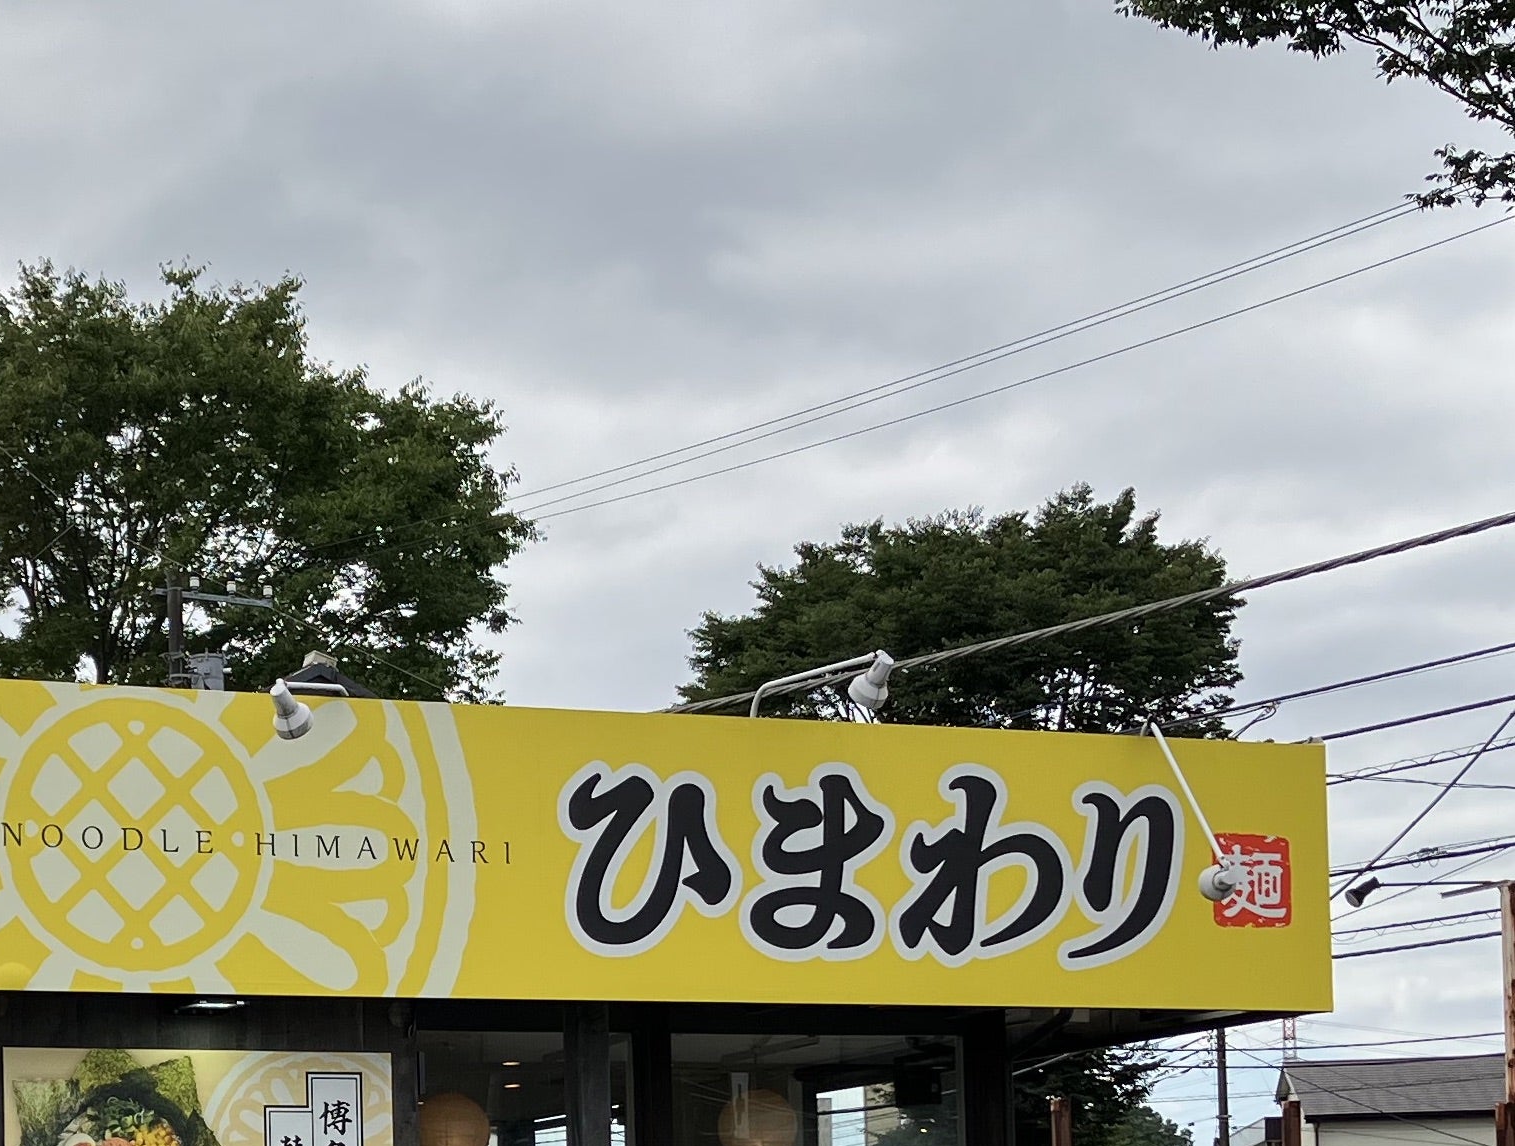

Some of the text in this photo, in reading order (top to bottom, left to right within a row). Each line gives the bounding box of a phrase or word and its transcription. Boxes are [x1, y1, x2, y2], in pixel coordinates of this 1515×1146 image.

[1, 821, 214, 855] NOODLE
[256, 832, 511, 865] HIMAWARI
[569, 773, 1175, 959] ひまわり
[1219, 843, 1287, 919] 麺
